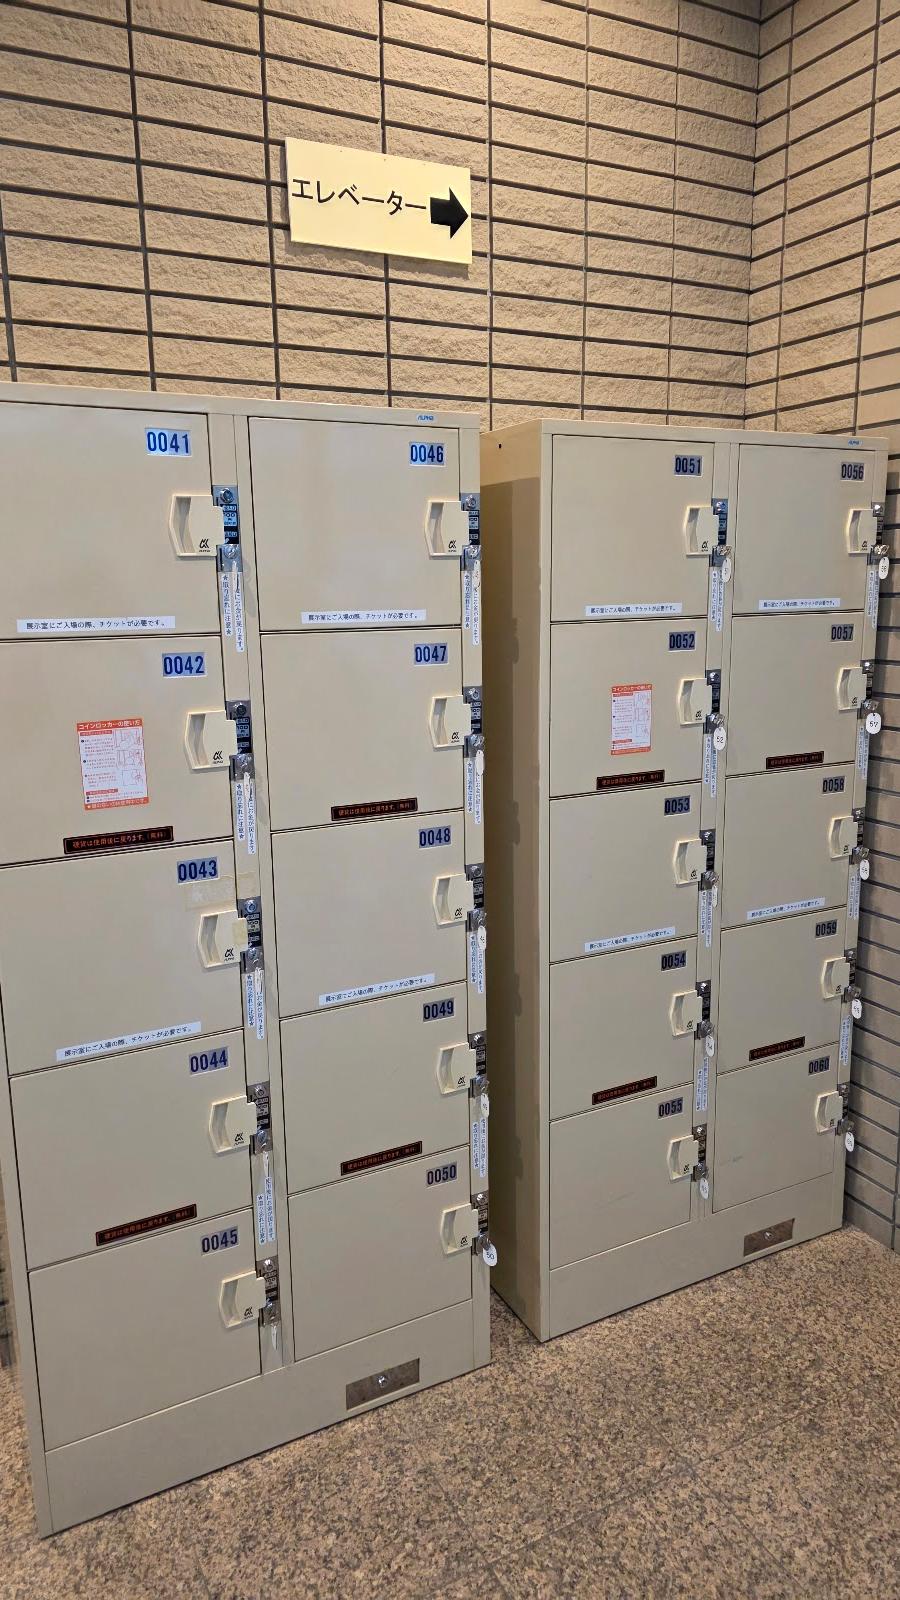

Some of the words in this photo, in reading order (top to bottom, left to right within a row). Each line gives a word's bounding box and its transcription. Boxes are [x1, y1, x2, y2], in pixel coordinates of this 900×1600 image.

[292, 178, 426, 215] エレベーター
[146, 431, 190, 454] 0041
[410, 445, 444, 463] 0046
[675, 457, 702, 473] 0051
[841, 463, 864, 479] 0056
[669, 633, 695, 649] 0052
[832, 626, 854, 640] 0057
[415, 645, 447, 663] 0047
[163, 655, 205, 675] 0042
[716, 736, 724, 744] 52
[823, 778, 845, 792] 0058
[664, 798, 690, 814] 0053
[419, 827, 451, 846] 0048
[178, 859, 217, 881] 0043
[815, 921, 837, 937] 0059
[661, 952, 686, 970] 0054
[423, 1000, 454, 1019] 0049
[190, 1049, 228, 1073] 0044
[808, 1058, 830, 1074] 0060
[659, 1099, 683, 1117] 0055
[427, 1164, 457, 1185] 0050
[201, 1228, 238, 1252] 0045
